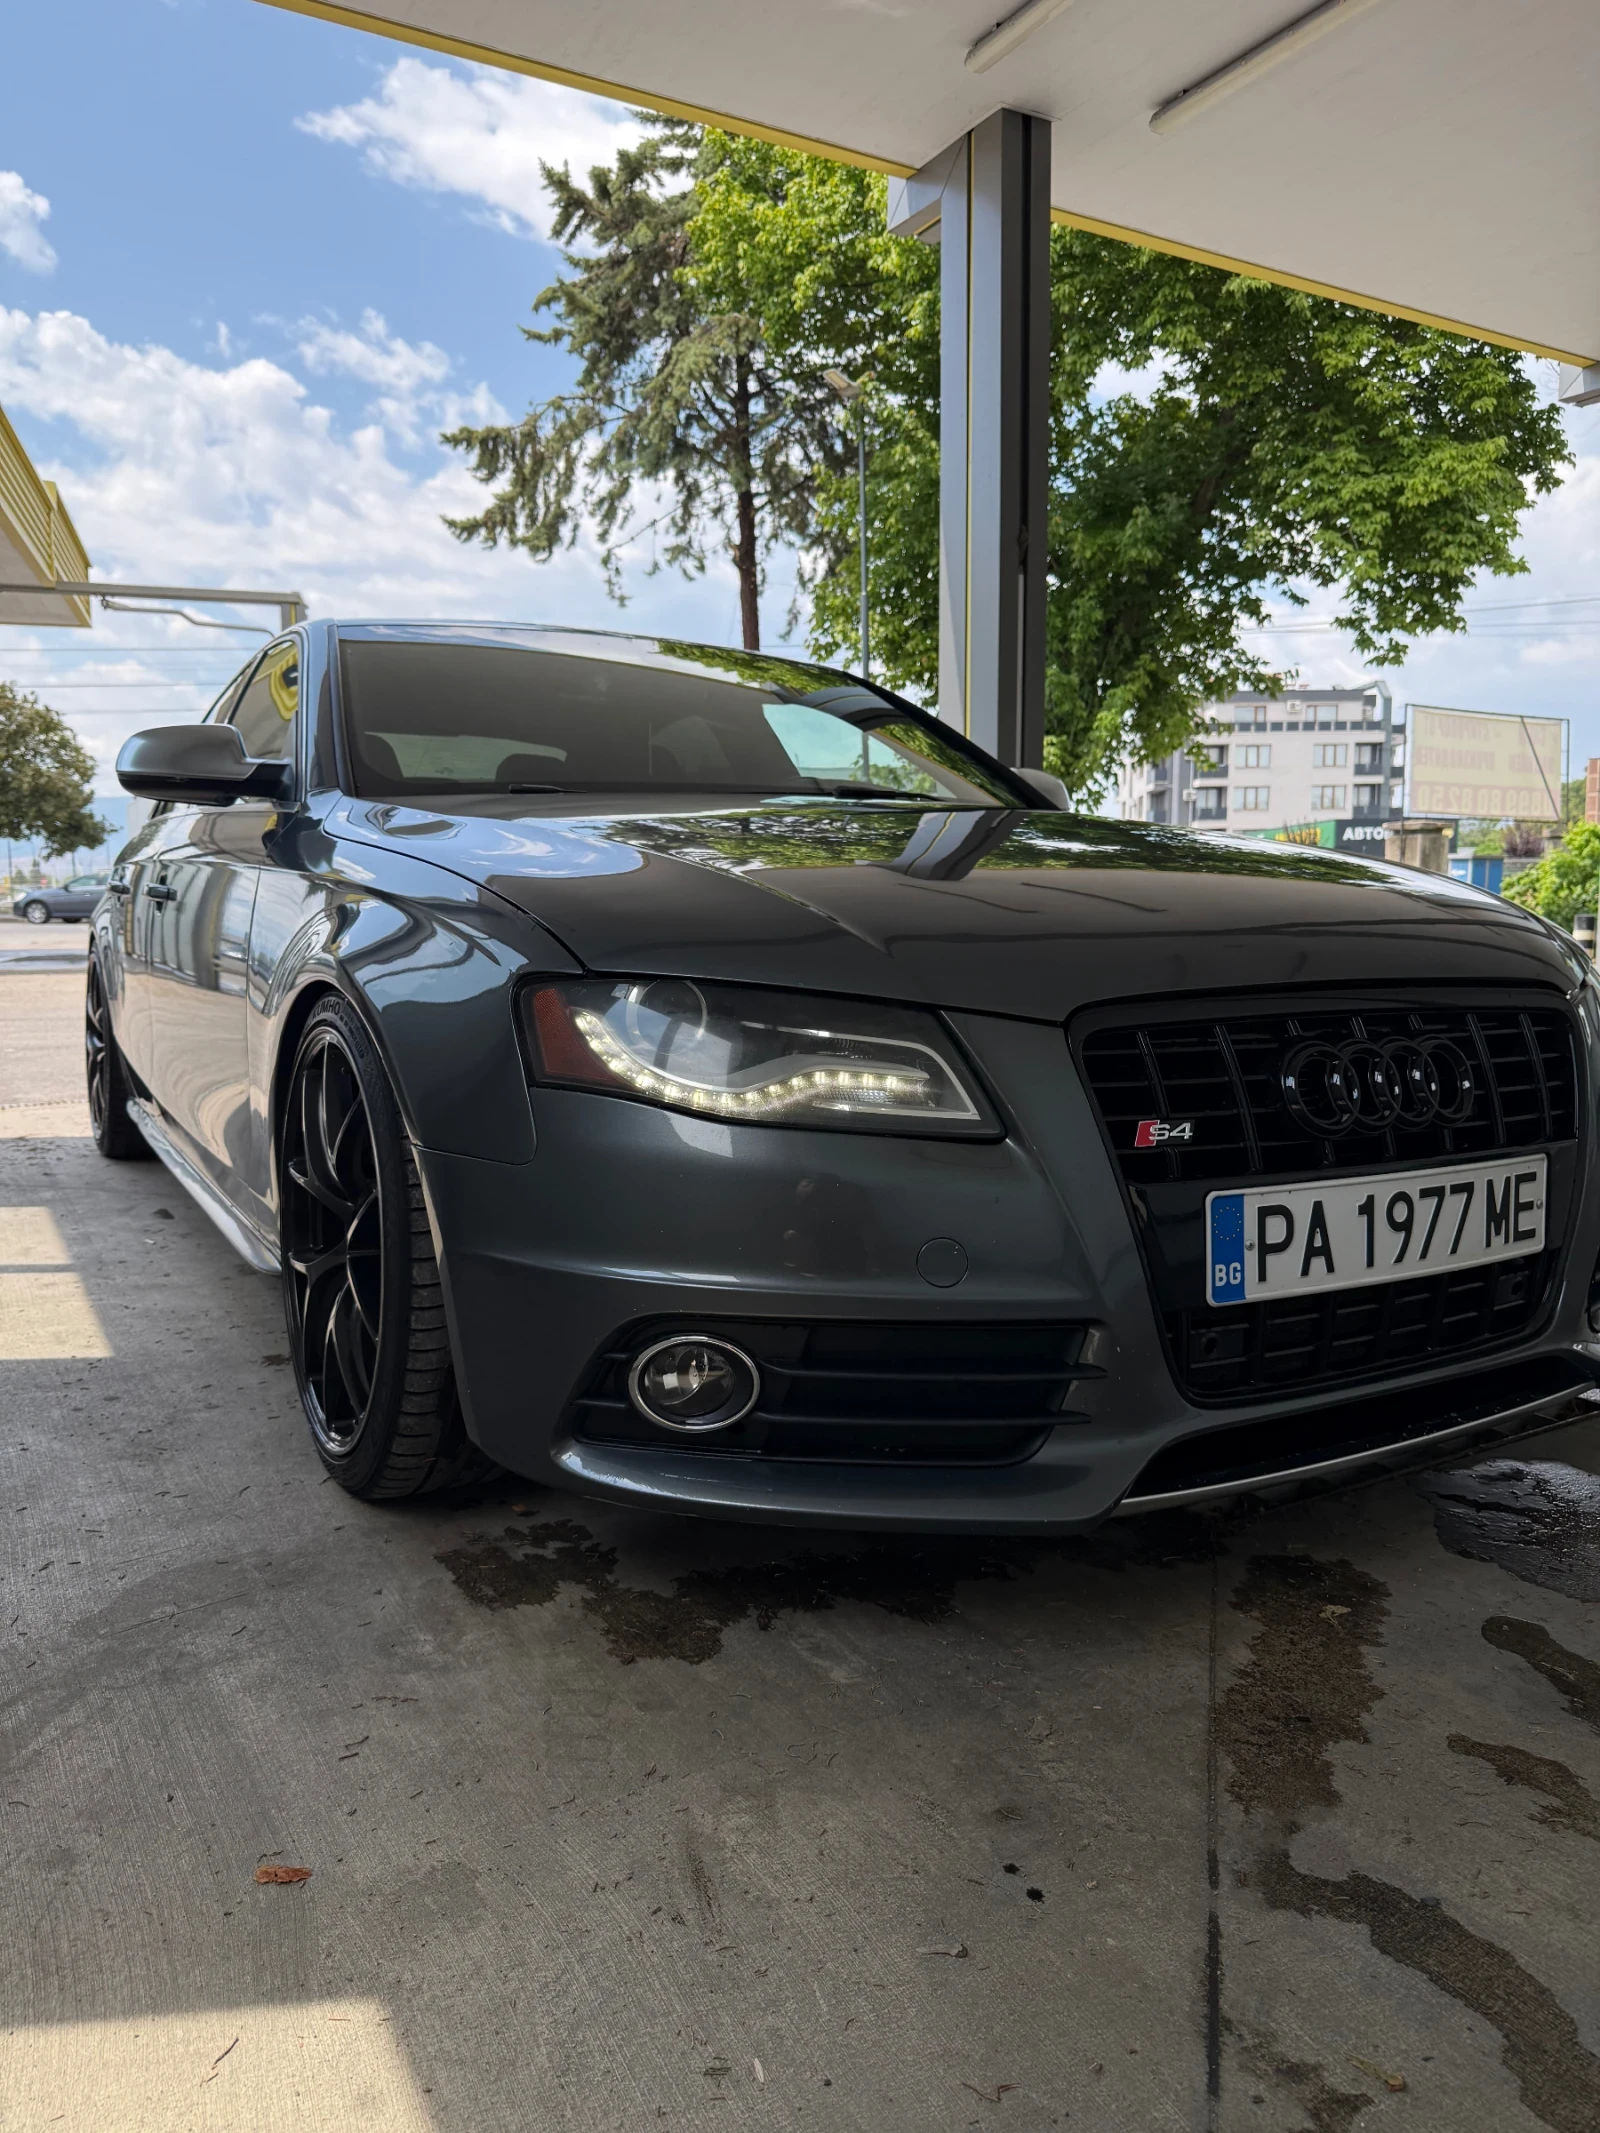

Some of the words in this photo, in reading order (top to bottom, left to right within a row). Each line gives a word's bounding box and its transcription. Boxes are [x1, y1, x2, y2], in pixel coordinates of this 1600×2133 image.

[1148, 1122, 1193, 1141] S4
[1357, 1181, 1474, 1268] 1977
[1215, 1262, 1242, 1287] BG
